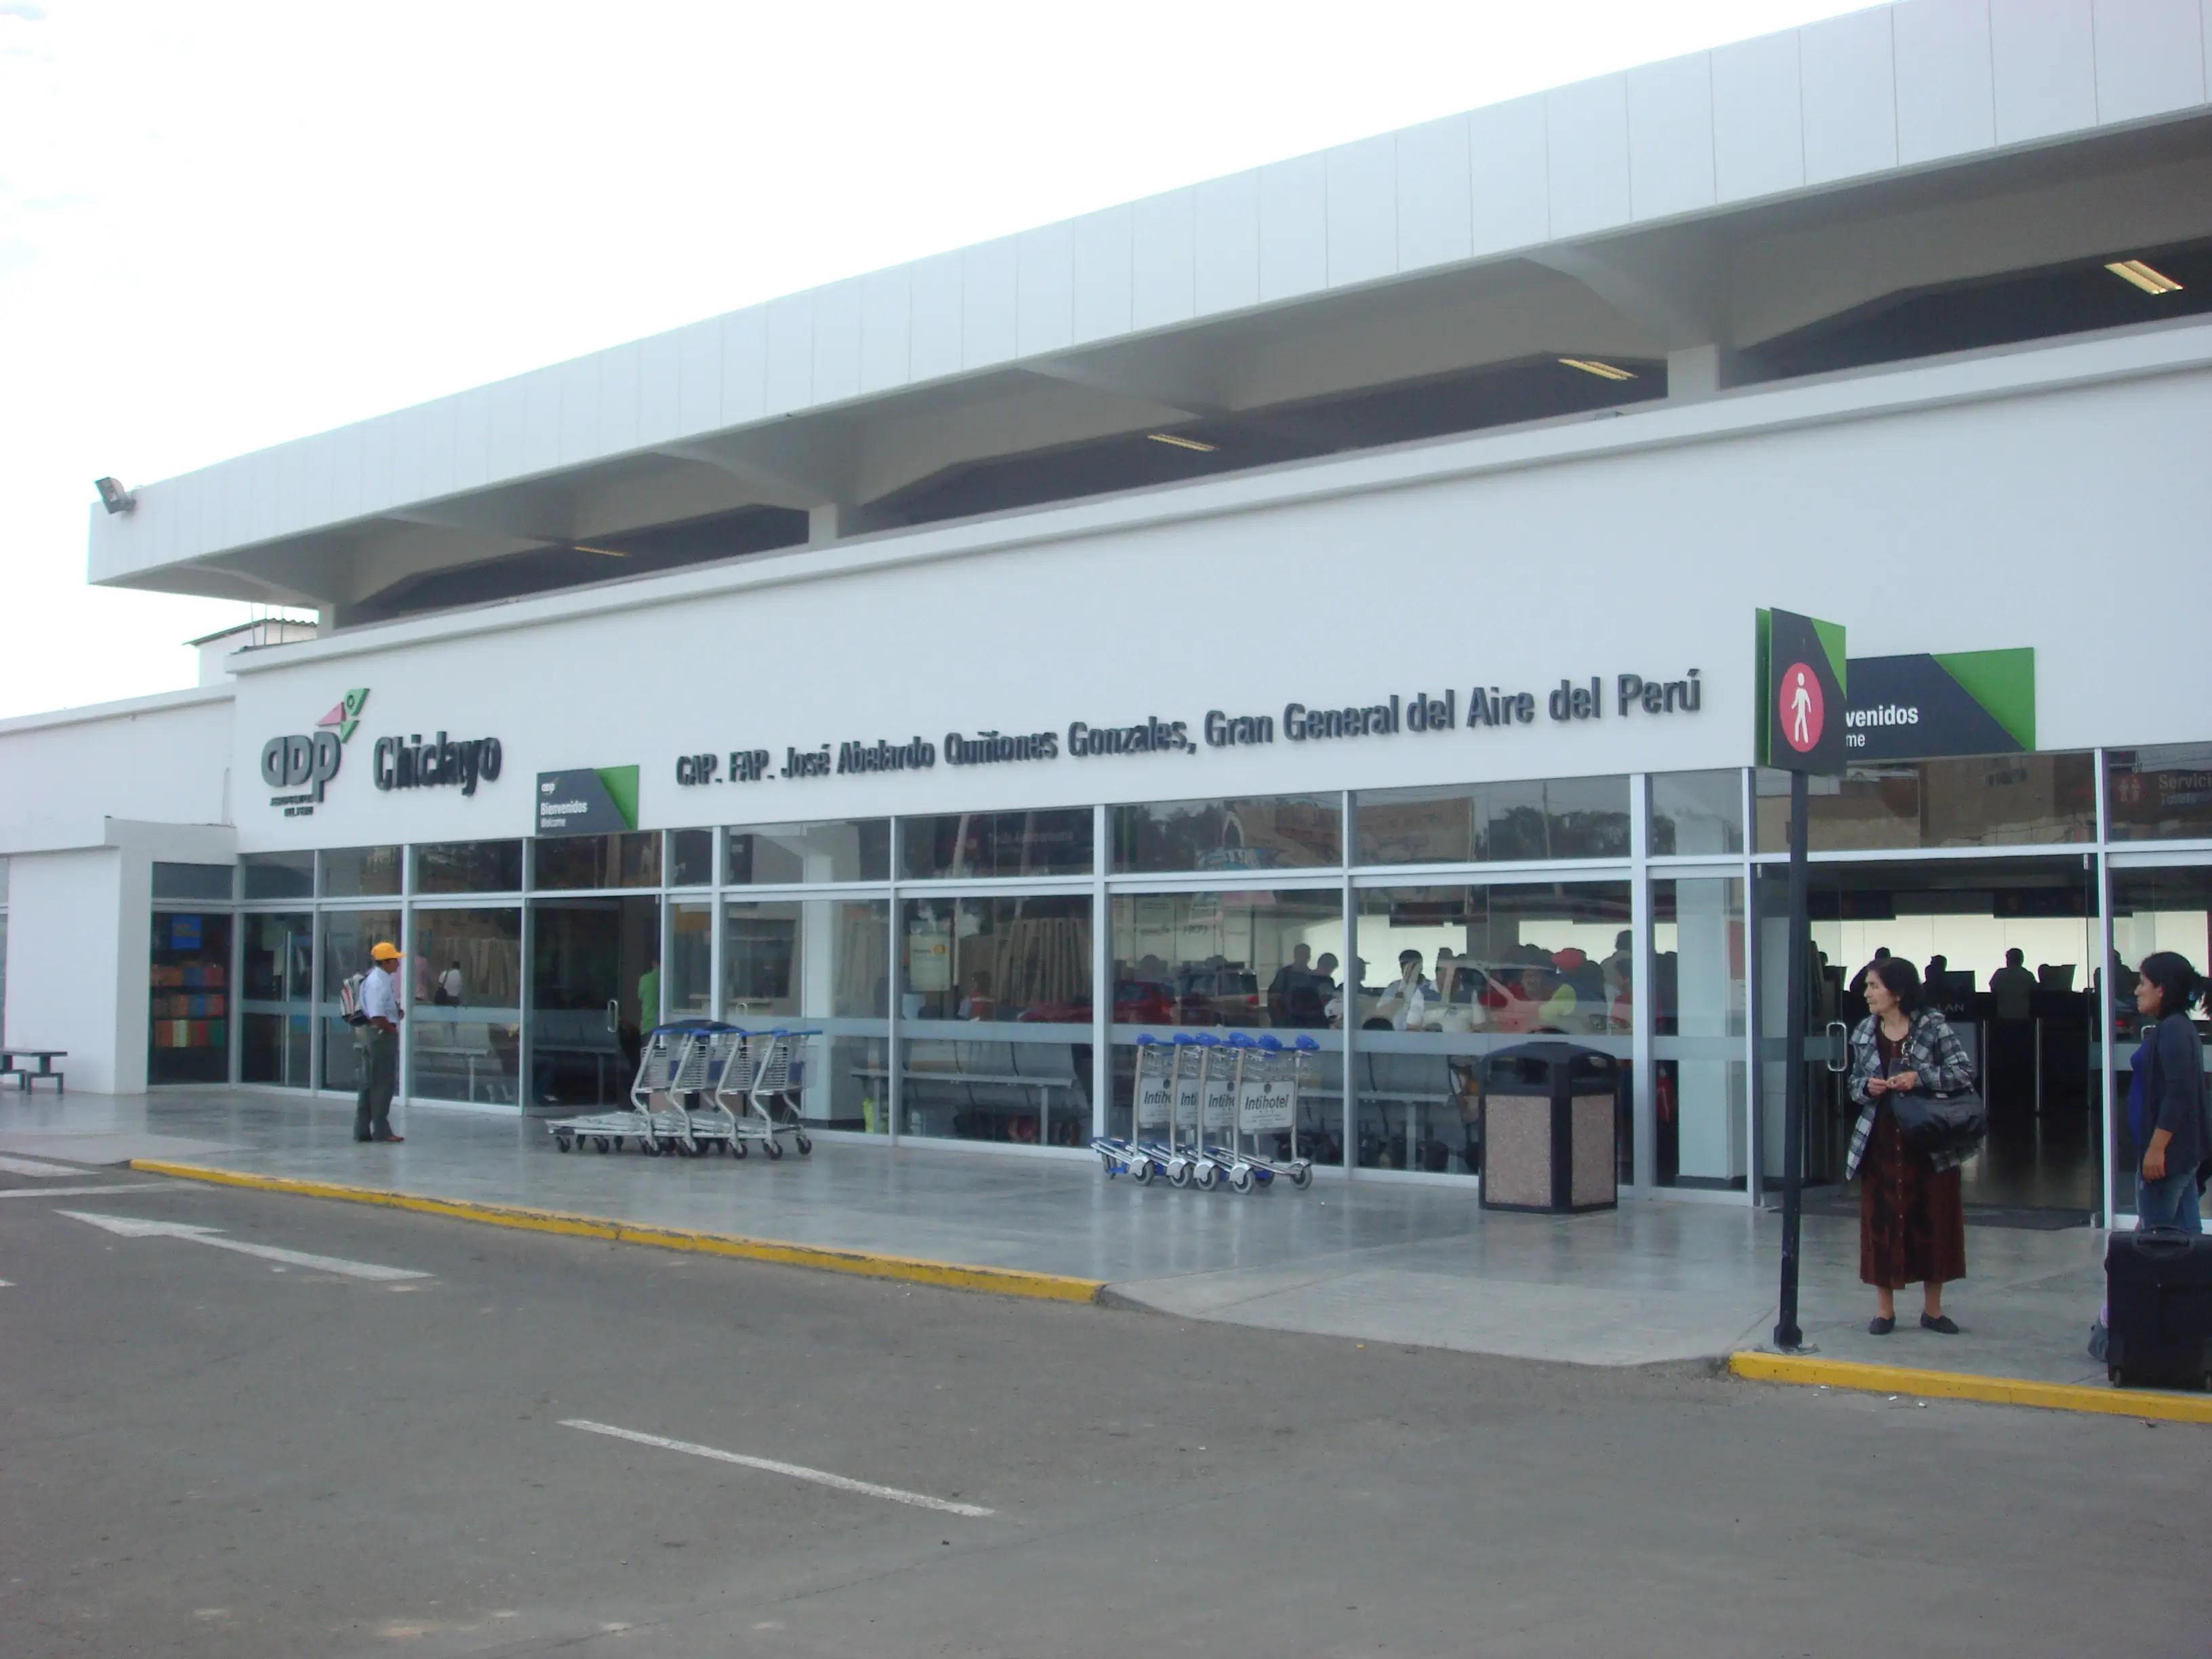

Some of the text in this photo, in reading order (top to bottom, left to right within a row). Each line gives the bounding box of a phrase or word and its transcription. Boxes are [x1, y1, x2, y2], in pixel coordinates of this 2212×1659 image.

[1845, 704, 1919, 727] venidos
[676, 668, 1701, 786] CAP. FAP. José Abelardo Quiñones Gonzales, Gran General del Aire del Perú
[373, 731, 502, 796] Chiclayo
[2158, 773, 2212, 790] Servici
[540, 800, 588, 816] Bienvenidos
[1244, 1093, 1290, 1111] Intihotel
